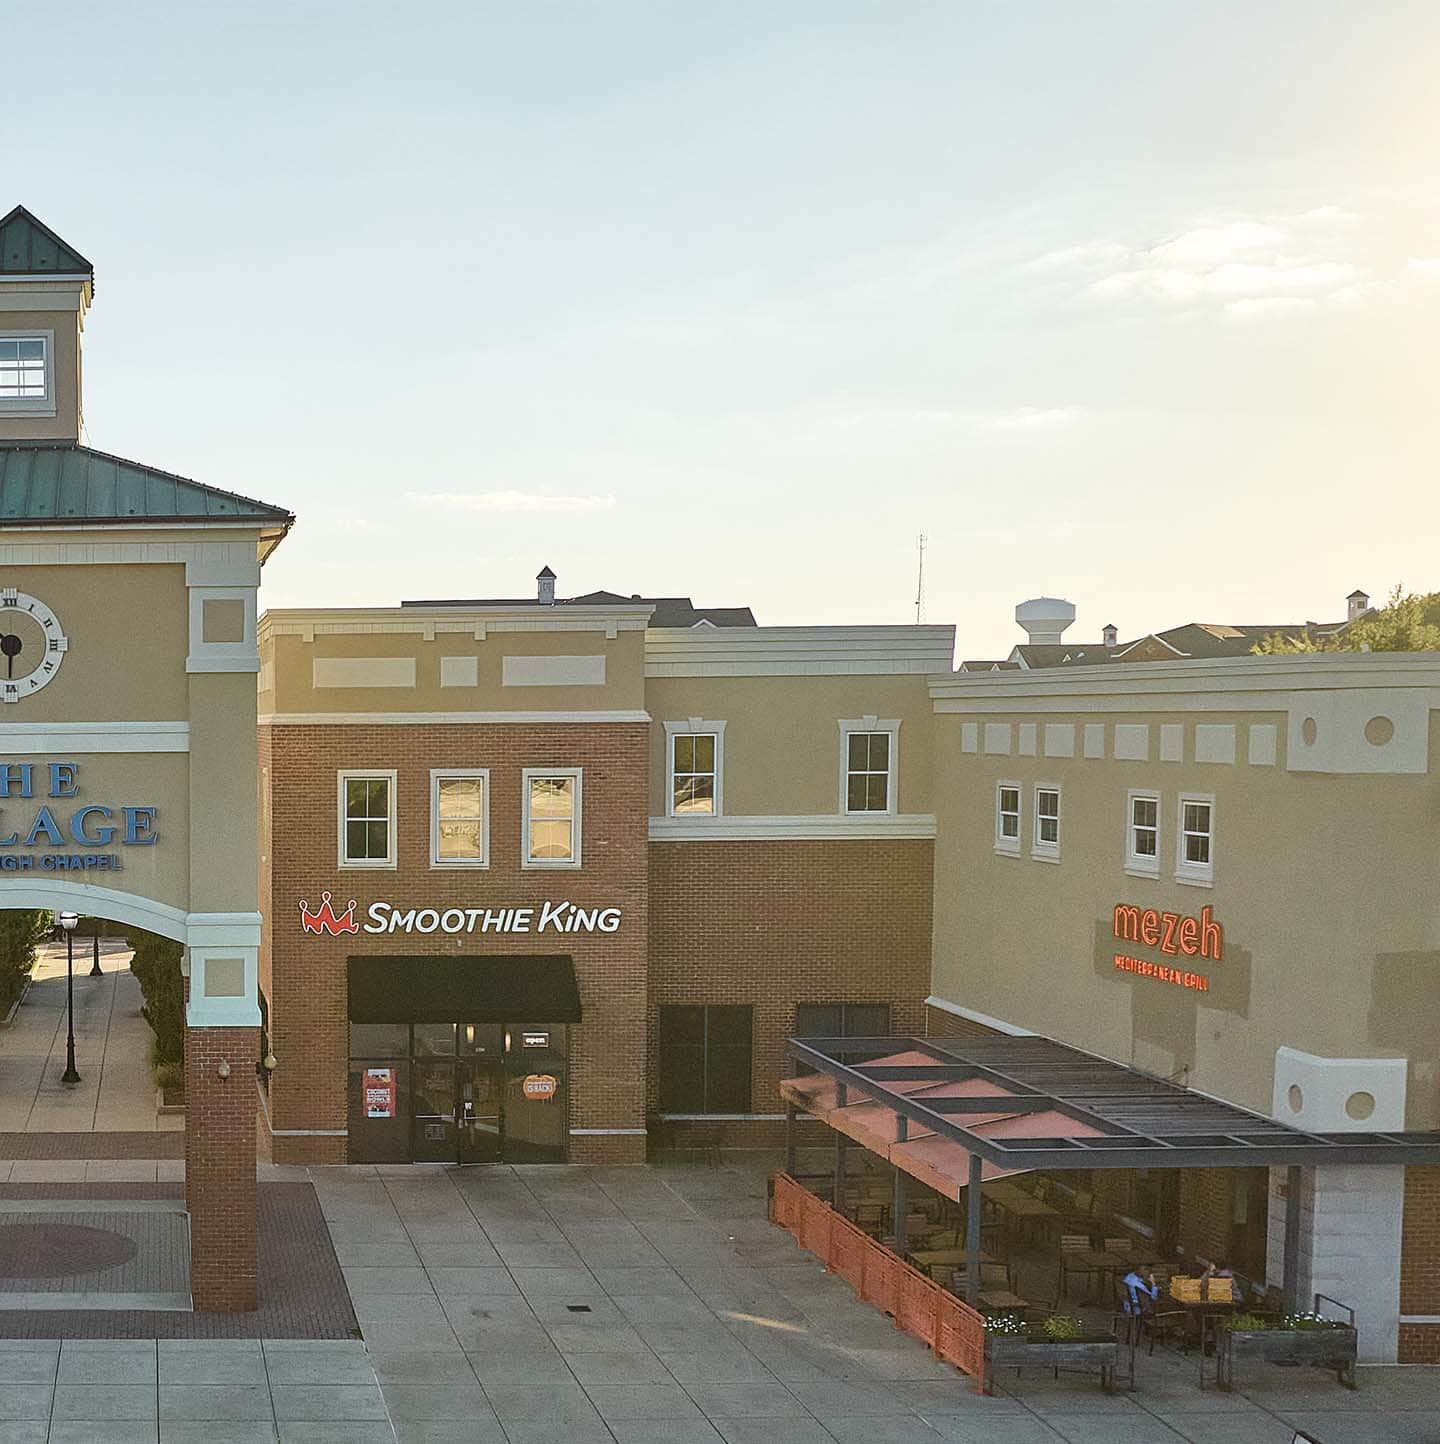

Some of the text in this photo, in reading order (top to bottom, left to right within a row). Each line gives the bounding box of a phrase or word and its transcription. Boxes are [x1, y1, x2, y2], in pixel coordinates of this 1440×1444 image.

[3, 598, 17, 606] XII
[43, 618, 53, 628] II
[50, 639, 58, 651] III
[44, 661, 54, 674] IV
[5, 684, 17, 693] VI
[29, 680, 38, 688] V
[39, 855, 123, 871] CHAPEL
[1113, 904, 1222, 960] mezeh
[1114, 955, 1209, 991] MEDITERRANEAN GRILL
